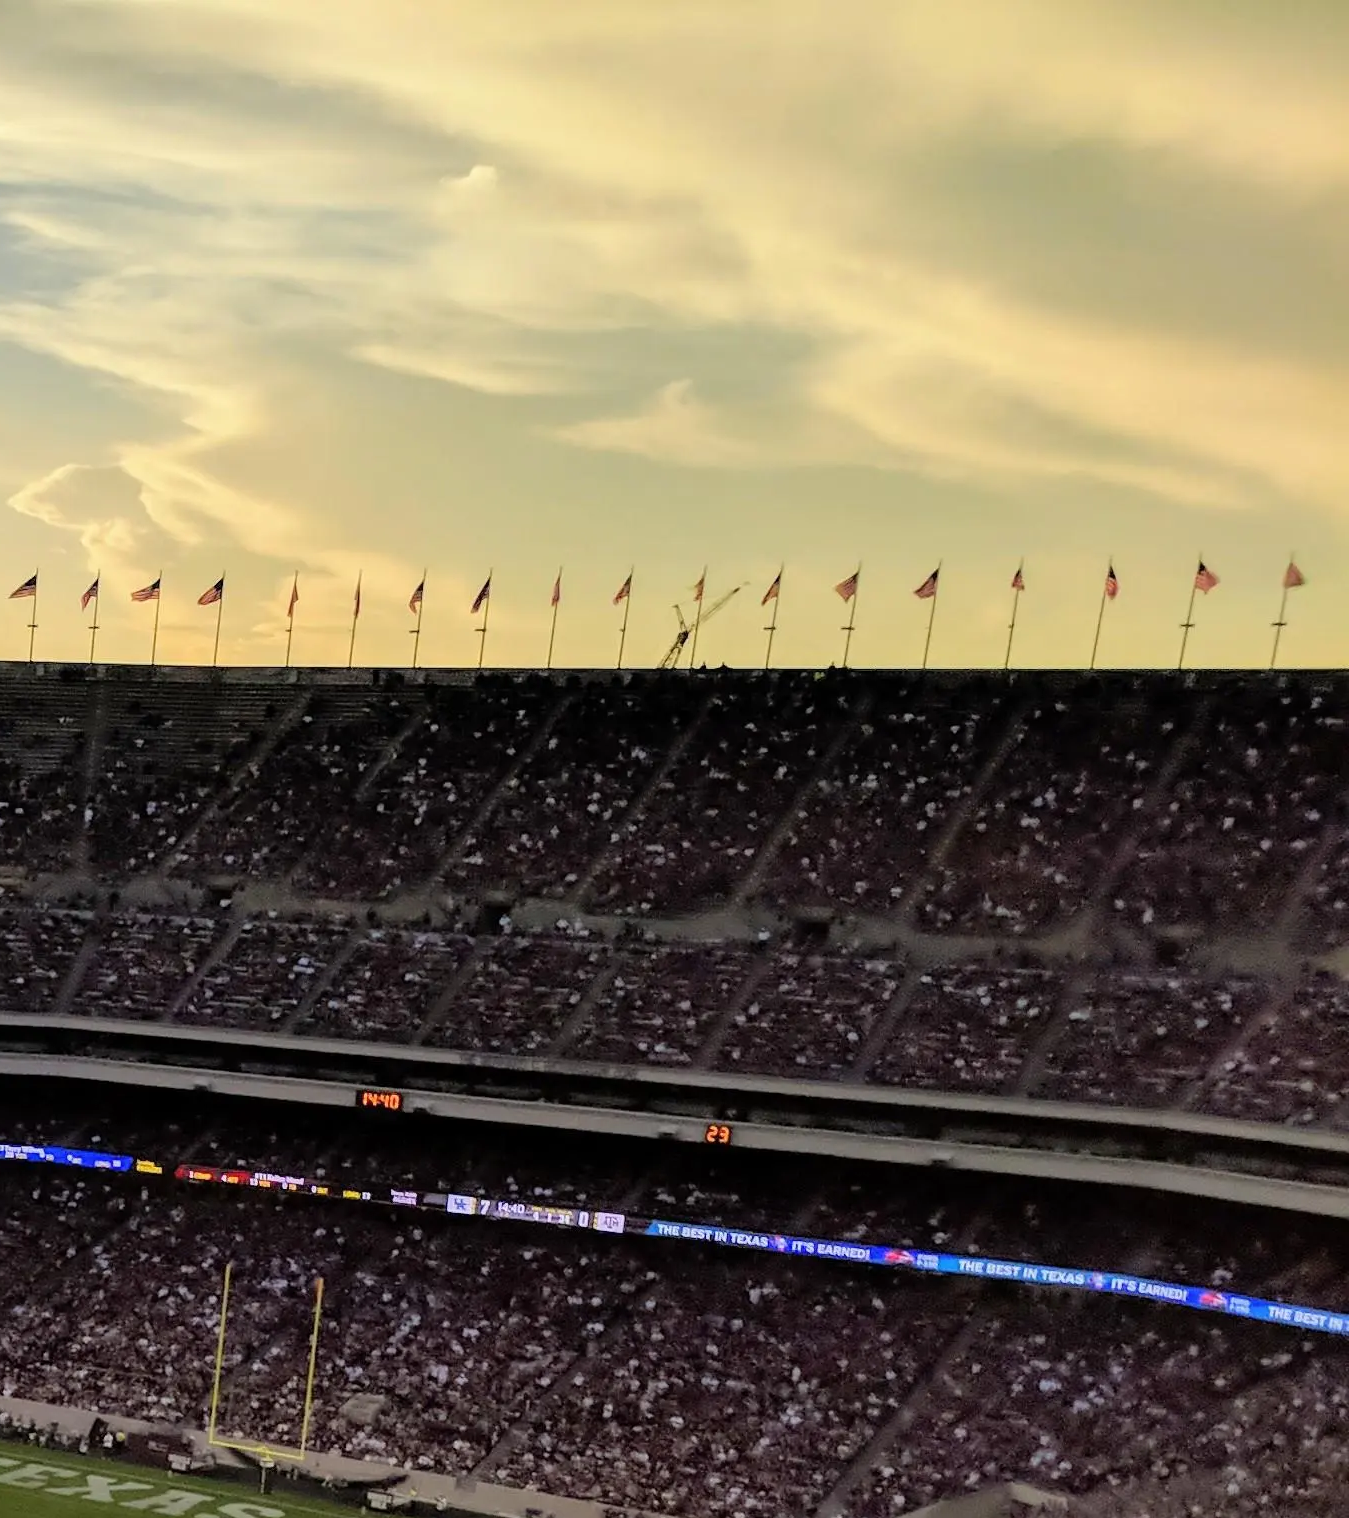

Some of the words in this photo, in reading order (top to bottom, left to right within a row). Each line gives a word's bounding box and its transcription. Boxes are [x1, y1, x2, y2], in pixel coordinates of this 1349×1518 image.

[362, 1092, 400, 1110] 14:40
[706, 1125, 730, 1143] 23
[480, 1200, 490, 1215] 7
[578, 1211, 589, 1227] 0
[658, 1224, 679, 1236] THE
[682, 1227, 713, 1241] BEST
[714, 1230, 728, 1243] IN
[730, 1232, 769, 1248] TEXAS
[792, 1241, 814, 1254] IT'S
[817, 1243, 870, 1260] EARNED!
[958, 1259, 983, 1273] THE
[986, 1262, 1021, 1277] BEST
[1022, 1267, 1037, 1279] IN
[1041, 1269, 1085, 1285] TEXAS
[1111, 1278, 1136, 1292] IT'S
[1138, 1282, 1187, 1301] EARNED!
[1268, 1306, 1292, 1321] THE
[1294, 1310, 1327, 1328] BEST
[1328, 1315, 1342, 1330] IN
